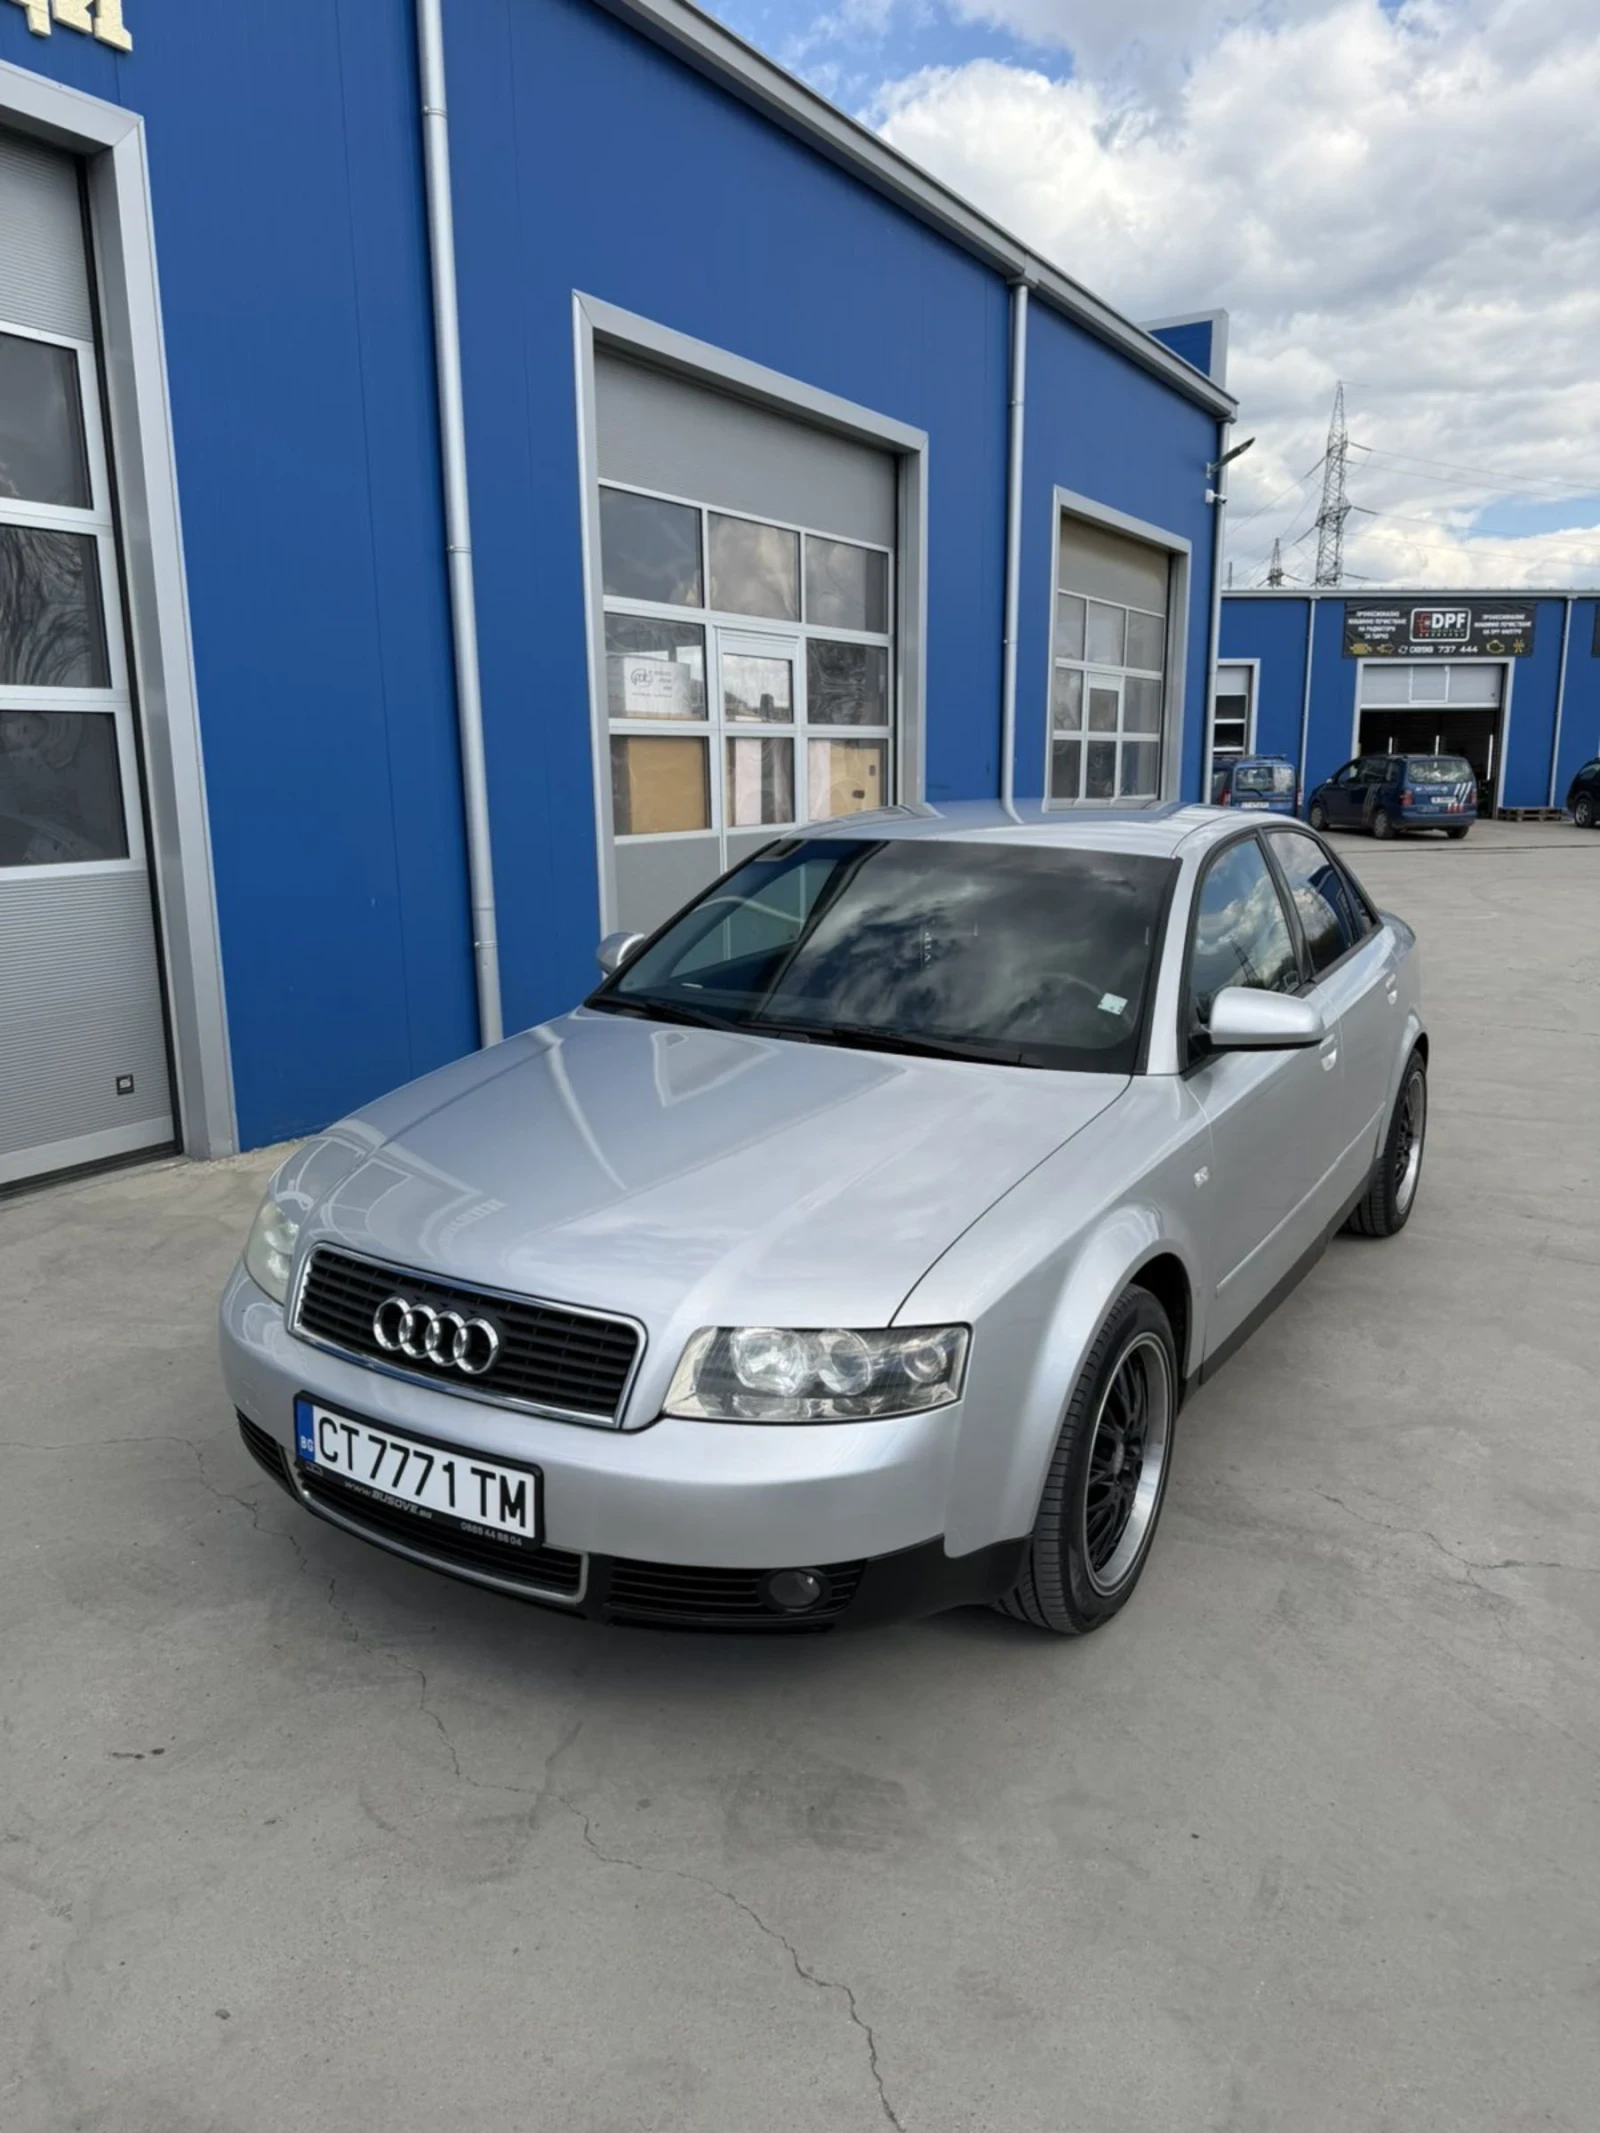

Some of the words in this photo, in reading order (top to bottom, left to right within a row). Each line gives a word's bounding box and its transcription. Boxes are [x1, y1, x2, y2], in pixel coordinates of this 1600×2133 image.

[1431, 613, 1467, 628] DPF
[300, 1434, 314, 1453] BG
[318, 1416, 360, 1471] CT
[368, 1436, 456, 1508] 7771
[471, 1466, 526, 1529] TM
